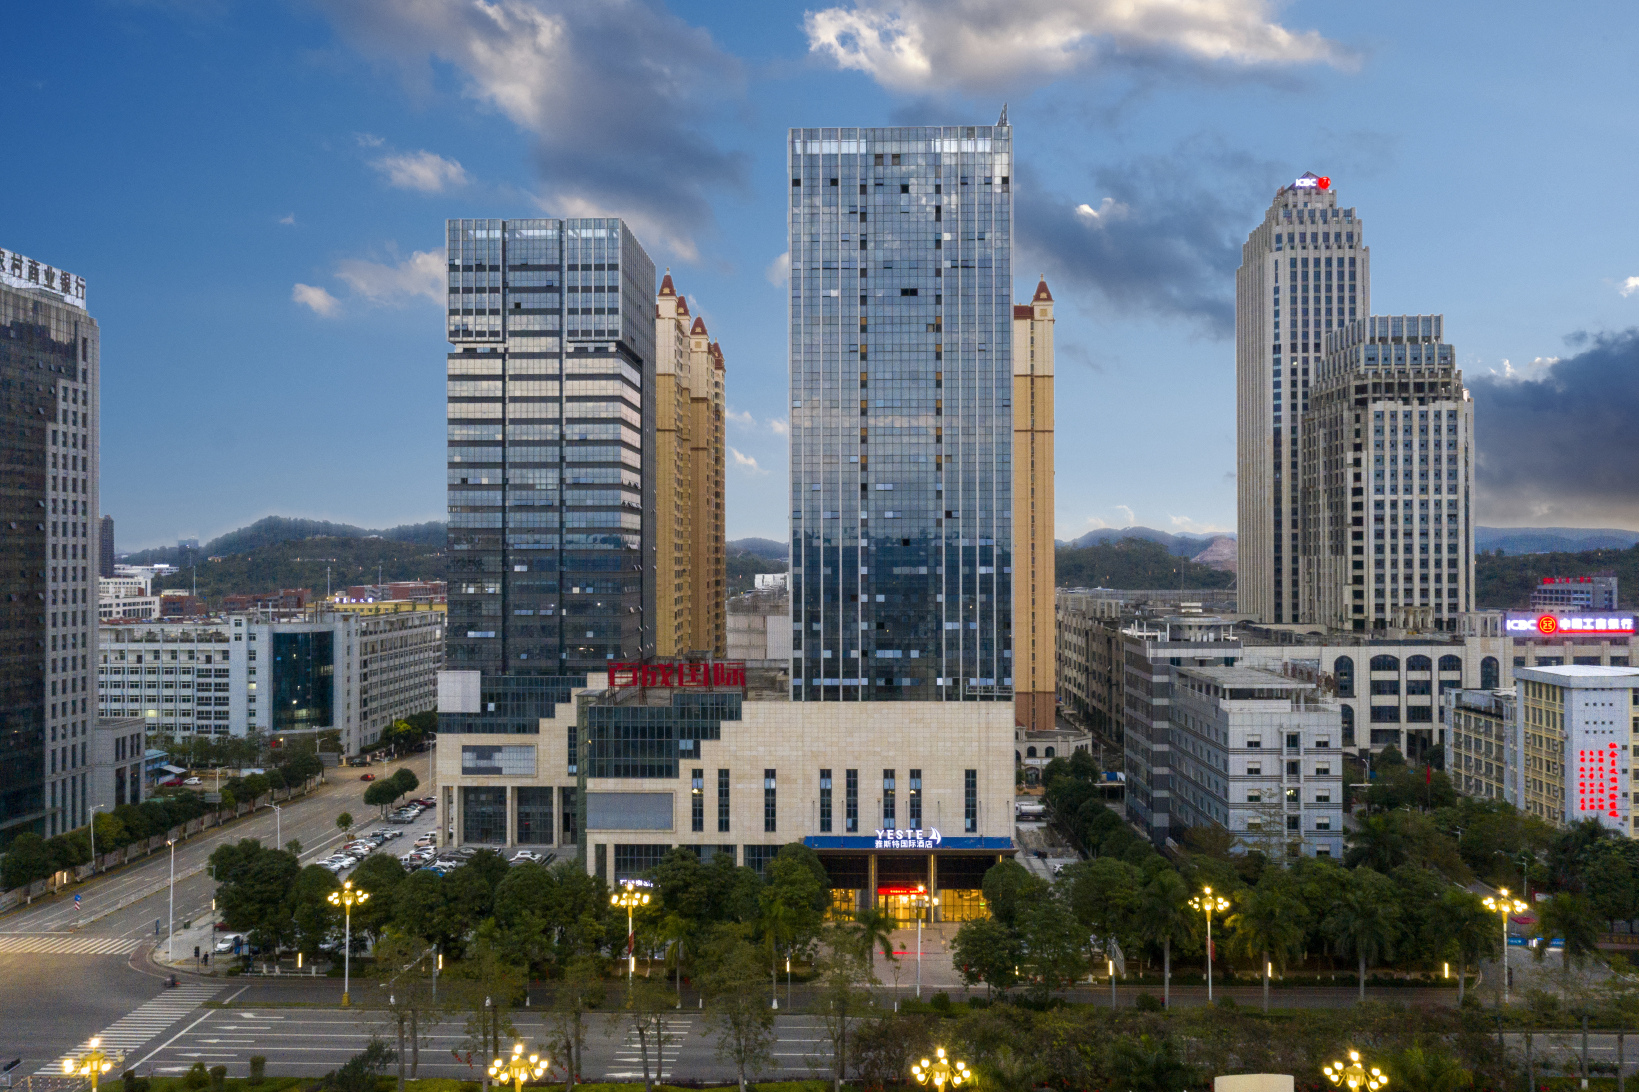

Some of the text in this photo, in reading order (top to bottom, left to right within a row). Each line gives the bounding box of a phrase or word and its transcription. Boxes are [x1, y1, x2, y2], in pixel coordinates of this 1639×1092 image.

[1506, 619, 1537, 631] ICBC
[607, 662, 746, 687] 百成国际
[875, 829, 924, 840] YESTE
[875, 840, 933, 849] 雅斯特国际酒店
